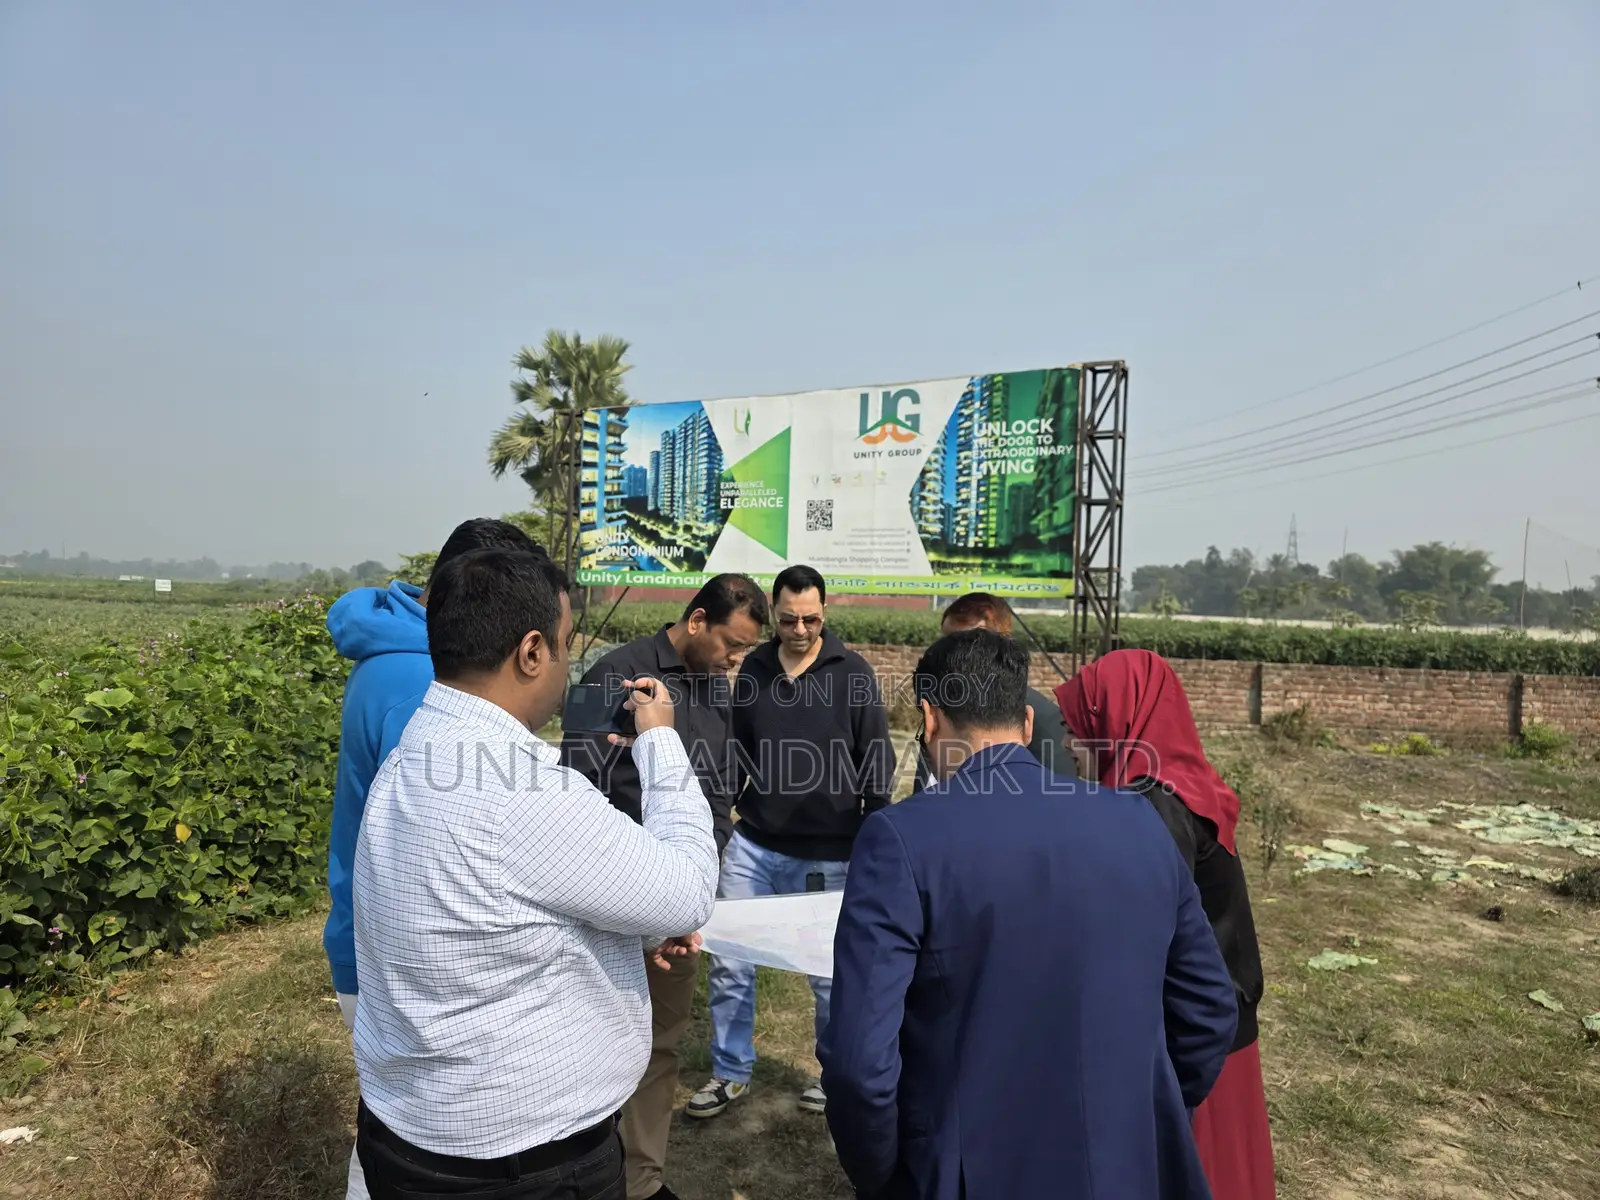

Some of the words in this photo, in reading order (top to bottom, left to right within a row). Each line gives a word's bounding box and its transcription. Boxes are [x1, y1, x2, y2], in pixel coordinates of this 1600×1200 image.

[973, 418, 1054, 437] UNLOCK
[973, 438, 995, 449] THE
[998, 435, 1034, 447] DOOR
[1036, 434, 1053, 445] TO
[853, 450, 883, 460] UNITY
[888, 448, 922, 458] GROUP
[972, 444, 1074, 459] EXTRAORDINARY
[972, 458, 1035, 476] LIVING
[720, 480, 765, 490] EXPERIENCE
[720, 488, 777, 497] UNPARALLELED
[720, 496, 784, 509] ELEGANCE
[595, 532, 630, 545] UNITY
[595, 545, 684, 558] CONDOMINIUM
[580, 572, 622, 586] Unity
